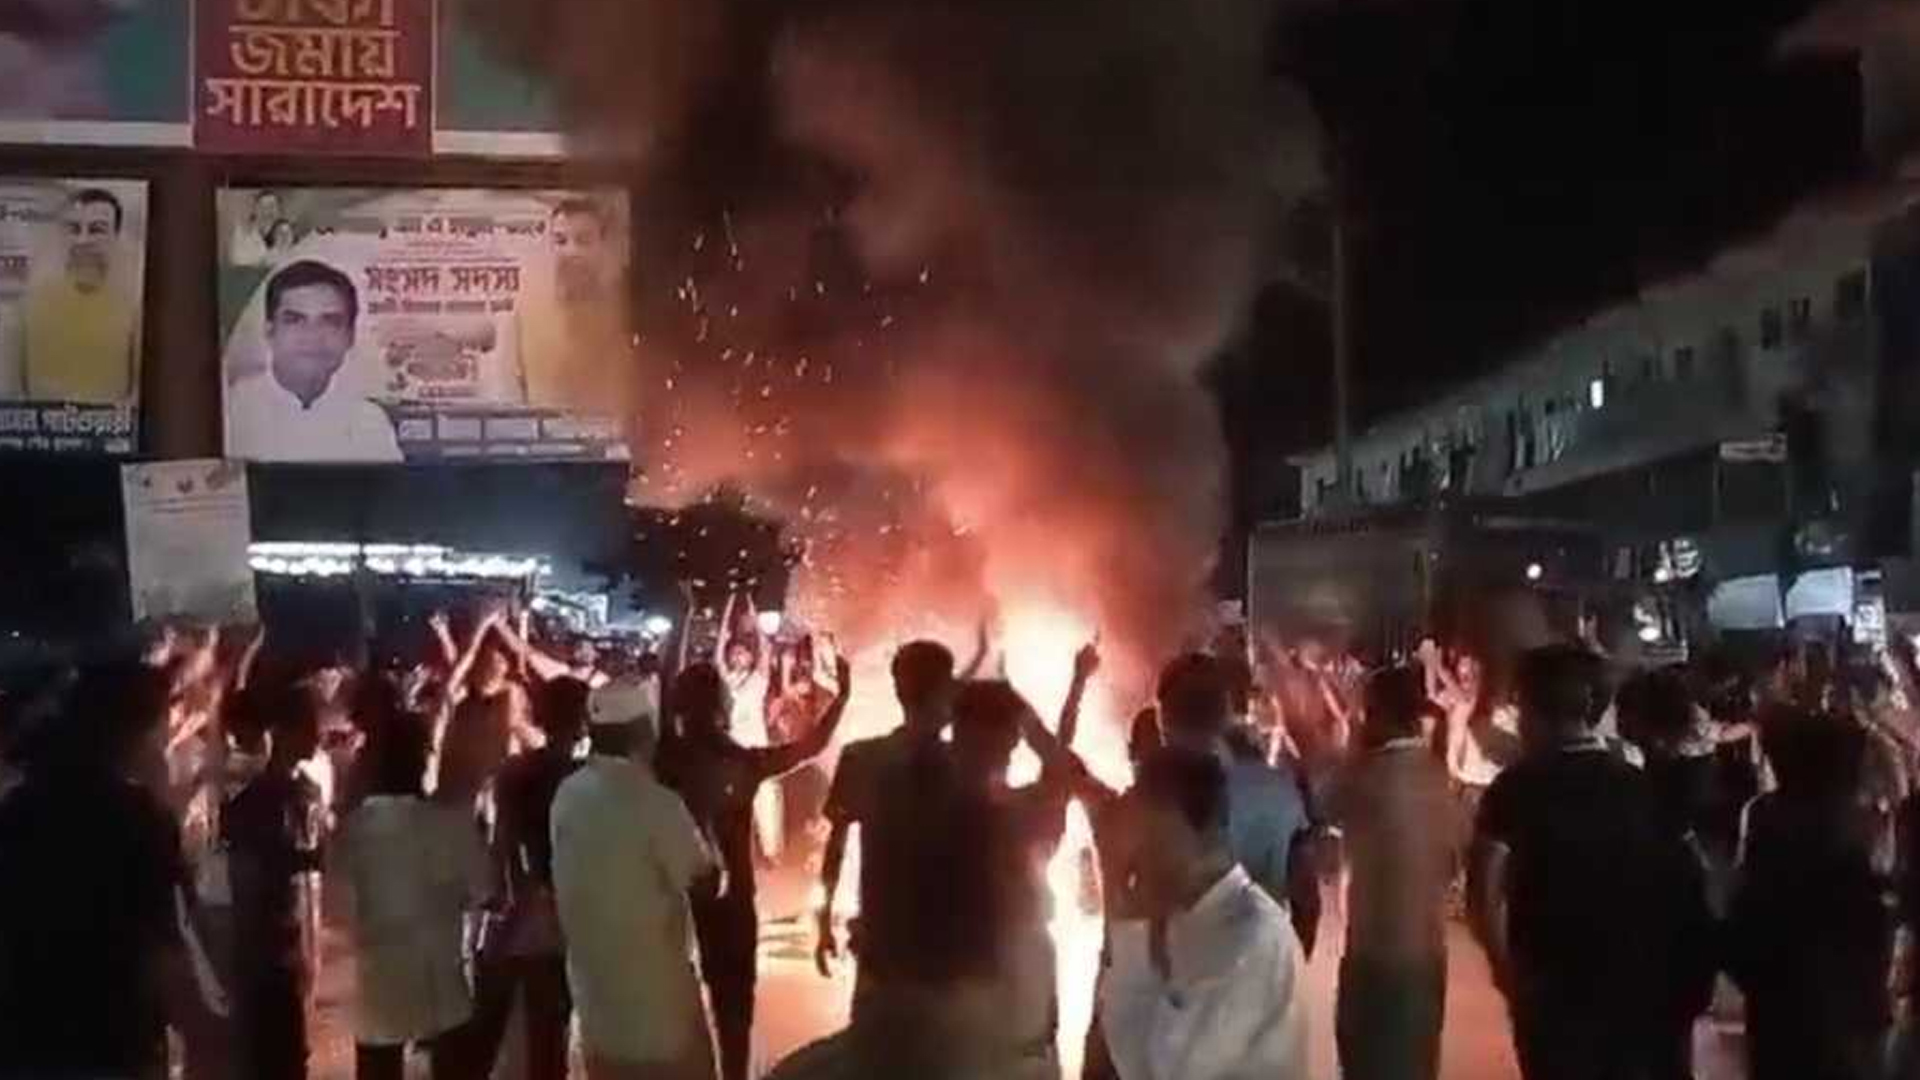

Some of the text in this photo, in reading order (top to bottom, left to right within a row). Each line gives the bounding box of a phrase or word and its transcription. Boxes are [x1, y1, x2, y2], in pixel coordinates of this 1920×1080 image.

[228, 25, 401, 77] জমায়
[205, 77, 422, 128] সারাদেশ
[364, 265, 522, 292] সংসদ সদস্য
